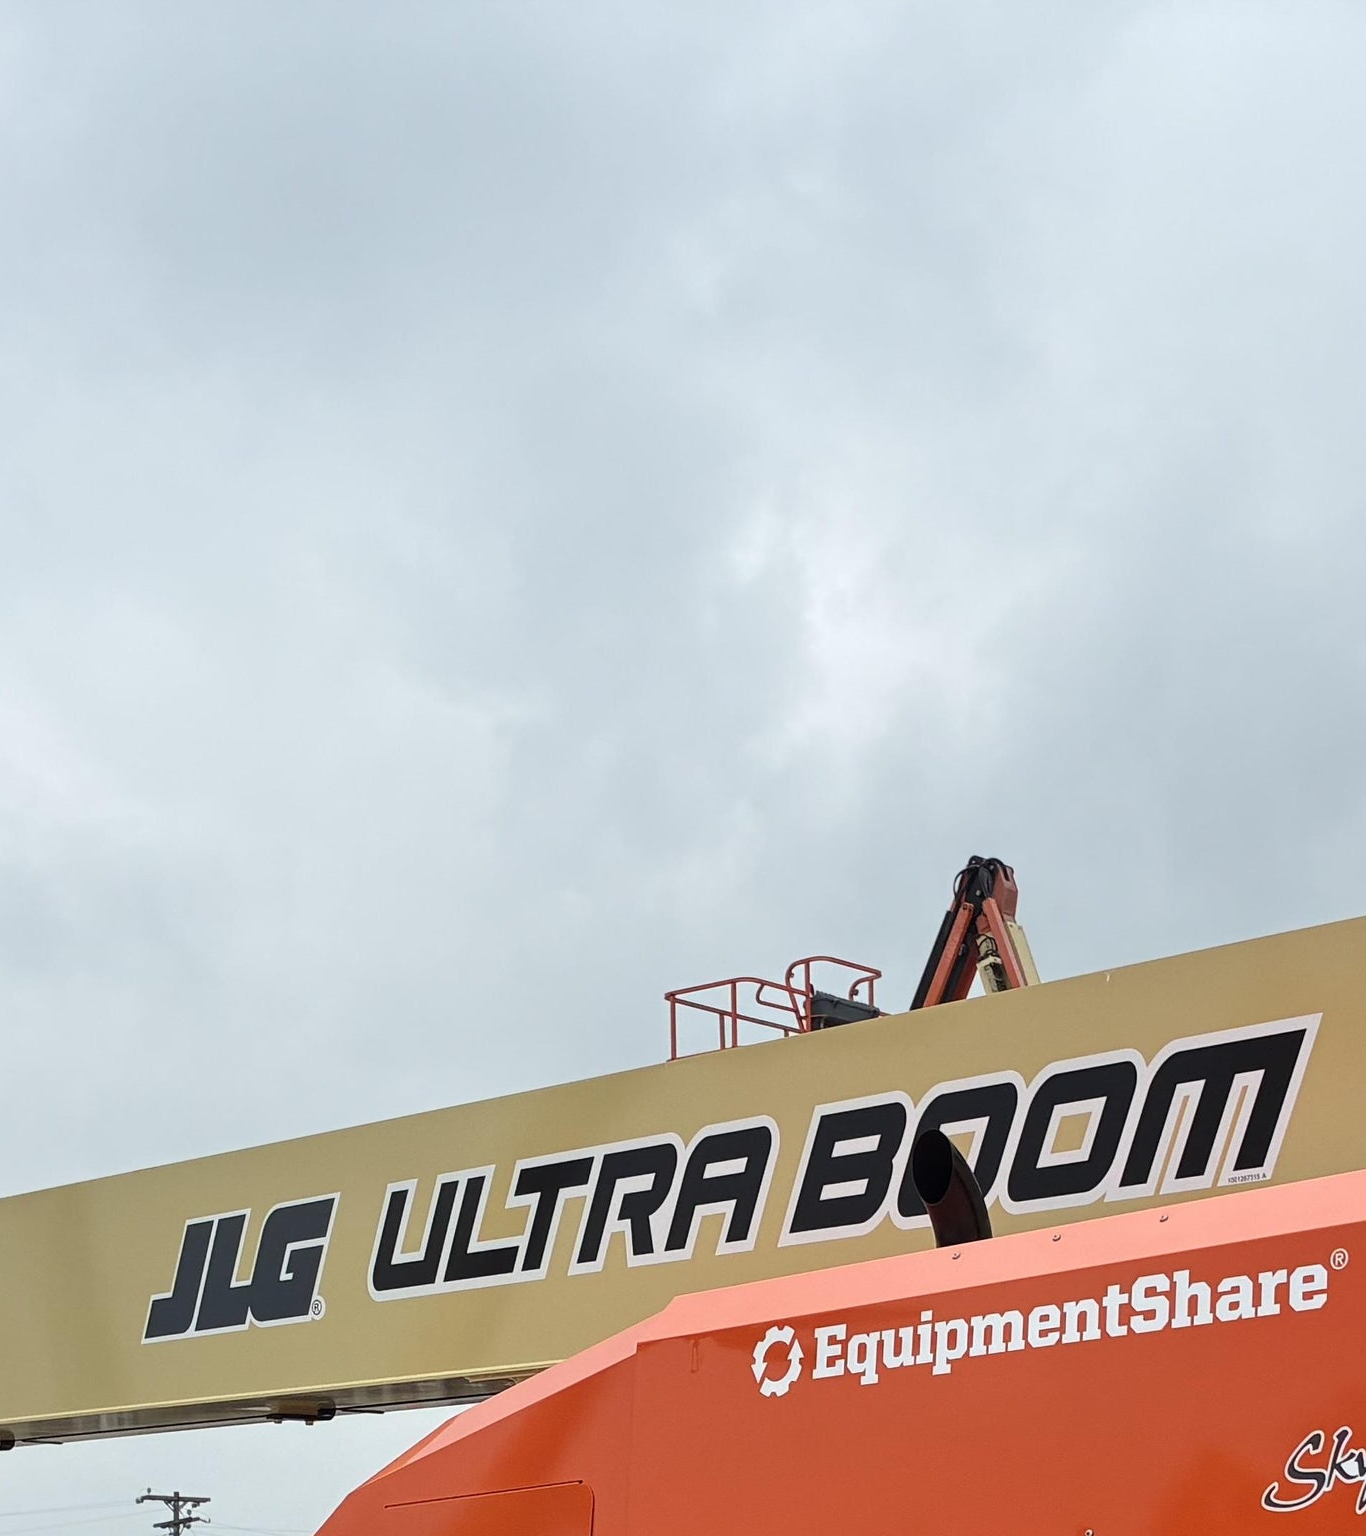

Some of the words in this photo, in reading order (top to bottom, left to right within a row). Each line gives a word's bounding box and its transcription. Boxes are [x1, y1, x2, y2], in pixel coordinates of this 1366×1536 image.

[142, 1194, 339, 1342] JLG
[370, 1117, 776, 1297] ULTRA
[785, 1018, 1320, 1238] BOOM
